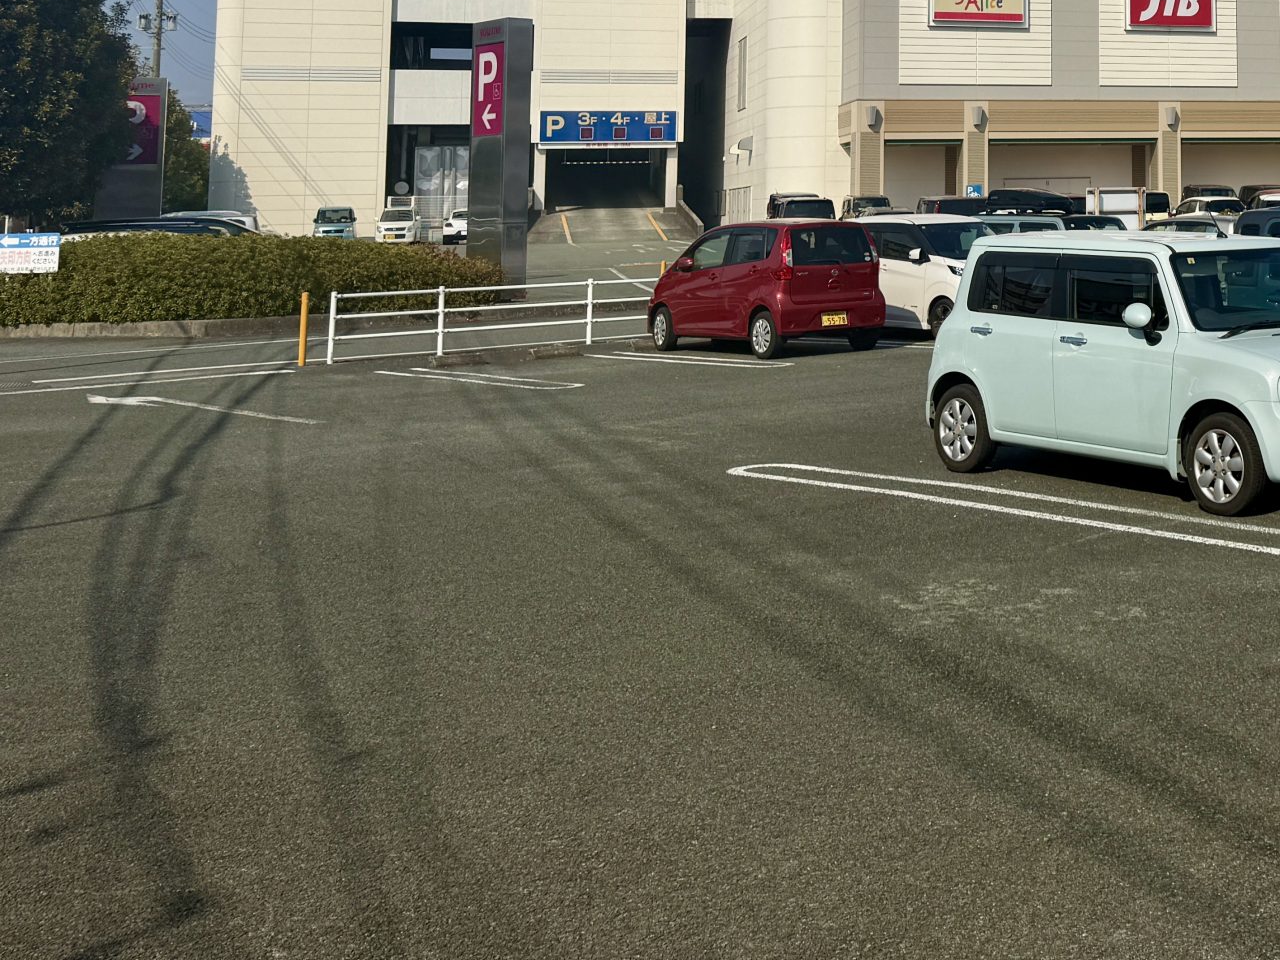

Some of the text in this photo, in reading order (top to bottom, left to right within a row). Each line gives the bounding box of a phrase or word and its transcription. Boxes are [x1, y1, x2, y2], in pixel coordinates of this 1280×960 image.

[478, 51, 498, 102] P
[546, 115, 566, 138] P
[20, 235, 58, 246] 一方通行
